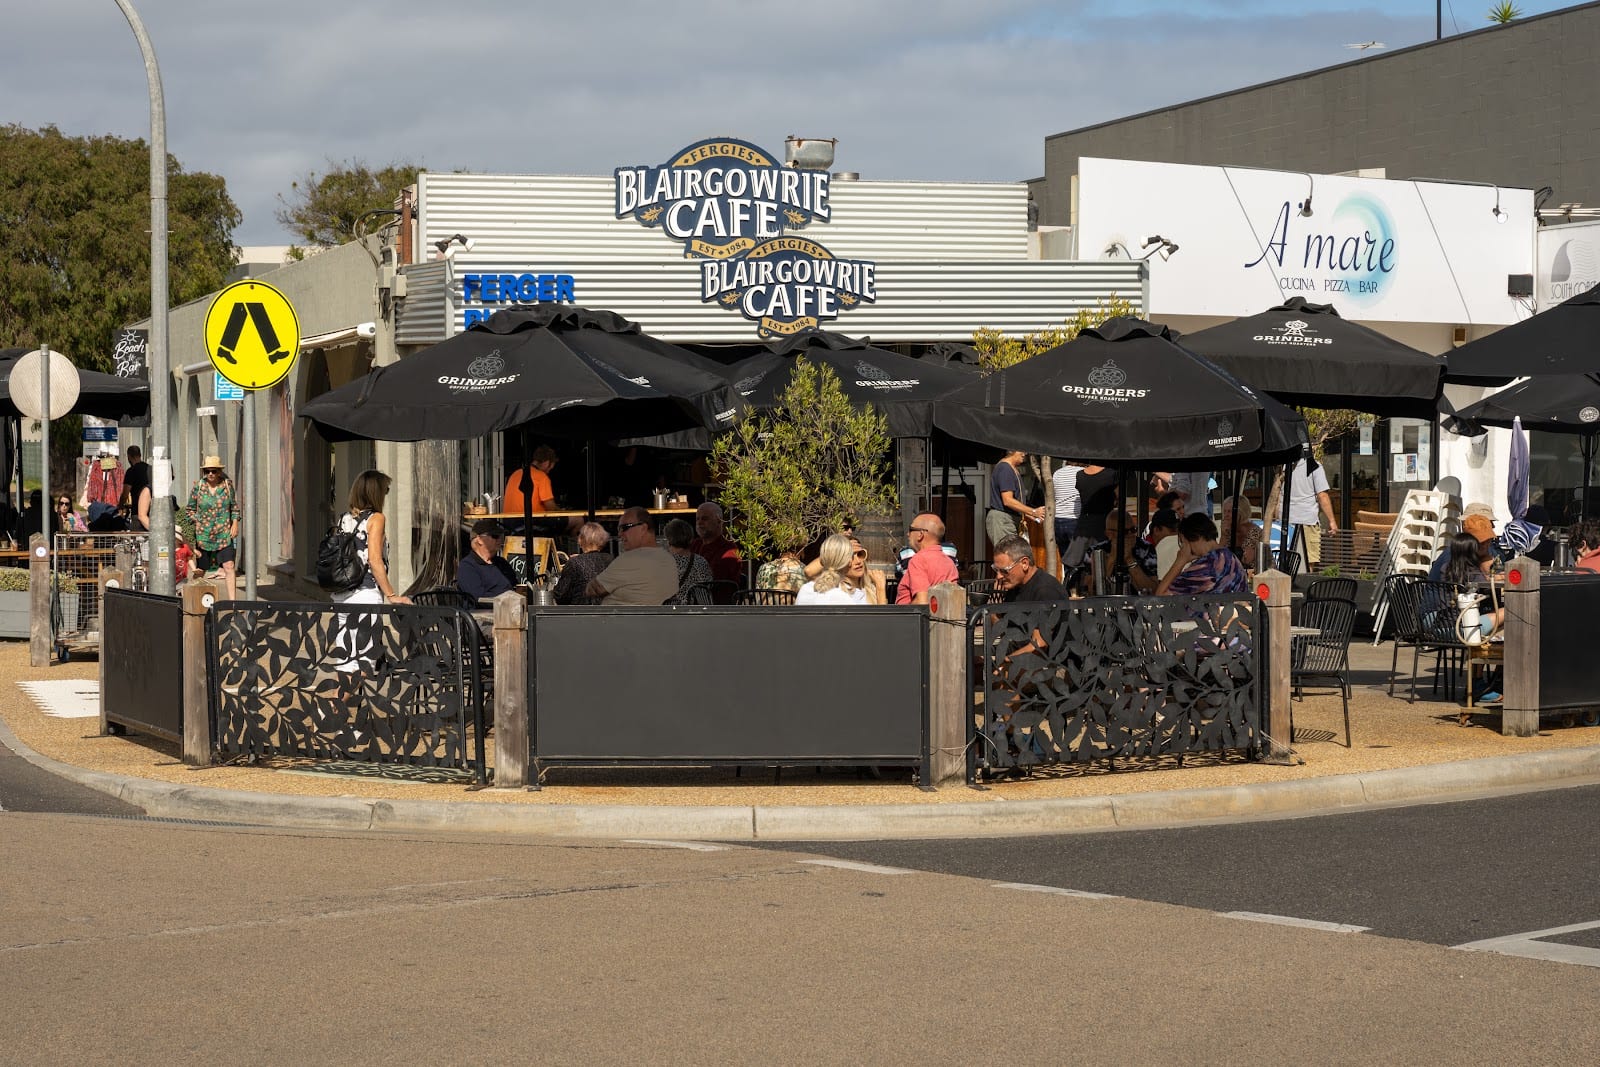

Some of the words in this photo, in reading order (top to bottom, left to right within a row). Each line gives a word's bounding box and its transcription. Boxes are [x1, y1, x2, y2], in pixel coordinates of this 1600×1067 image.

[691, 145, 754, 162] FERGIES
[618, 168, 830, 218] BLAIRGOWRIE
[666, 198, 780, 238] CAFE
[698, 244, 715, 256] EST
[726, 240, 747, 255] 1984
[761, 240, 817, 255] FERGIES
[464, 274, 576, 302] FERGER
[704, 259, 875, 301] BLAIRGOWRIE
[1279, 277, 1316, 291] CUCINA
[1324, 279, 1350, 292] PIZZA
[1359, 280, 1378, 293] BAR
[1551, 282, 1573, 300] SOUTH
[743, 285, 838, 317] CAFE
[767, 320, 783, 331] EST
[792, 318, 810, 331] 1984
[113, 338, 145, 359] Beach
[1253, 335, 1333, 345] GRINDERS
[117, 361, 141, 378] Bar
[438, 374, 516, 386] GRINDERS
[1062, 385, 1147, 398] GRINDERS
